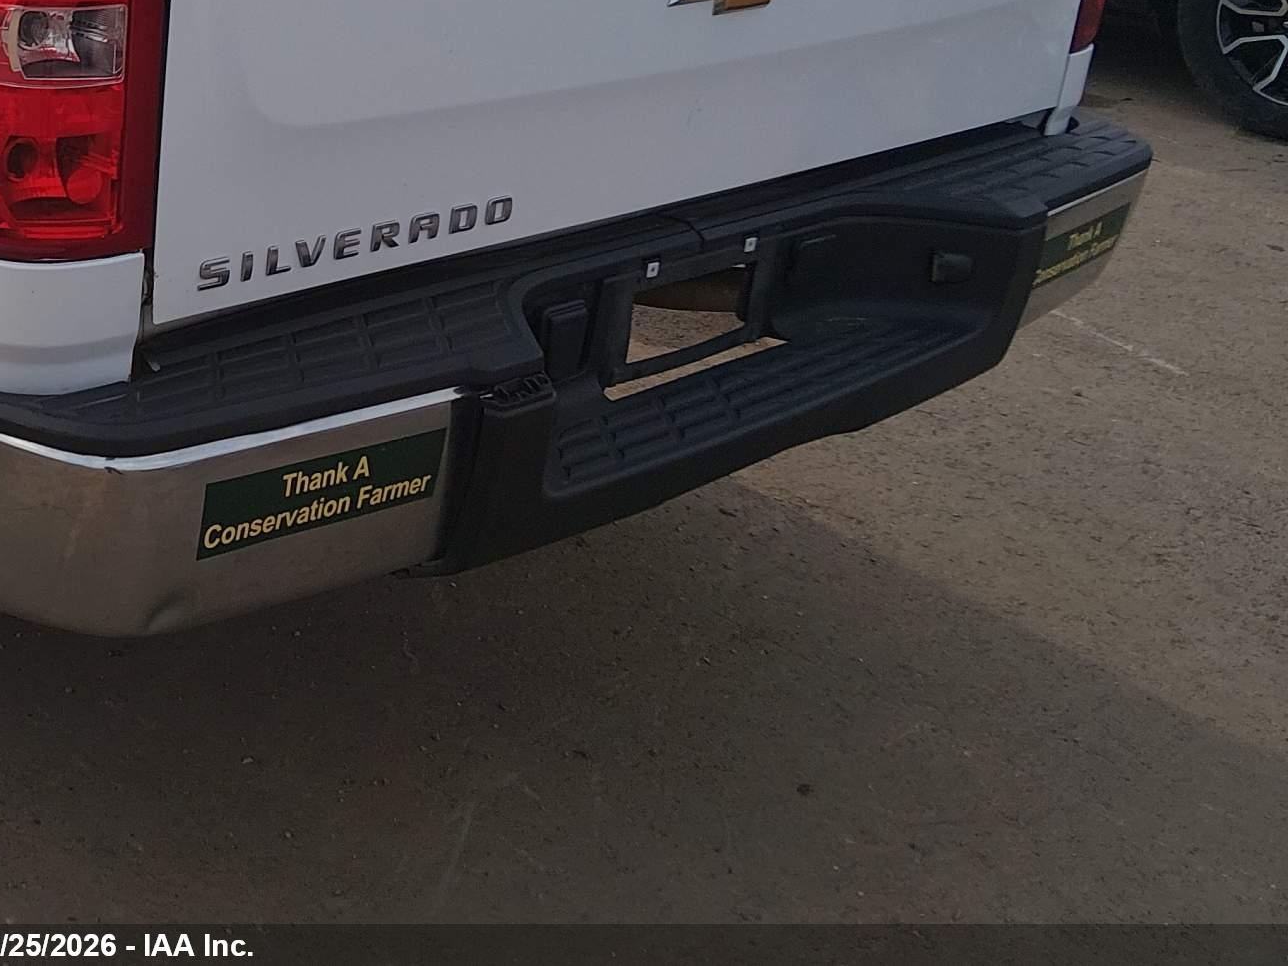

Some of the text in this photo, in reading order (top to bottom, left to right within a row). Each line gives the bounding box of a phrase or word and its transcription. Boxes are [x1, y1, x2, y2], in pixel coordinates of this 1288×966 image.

[197, 195, 513, 291] SILVERADO
[203, 474, 432, 549] Conservation Farmer
[282, 455, 371, 498] Thank A
